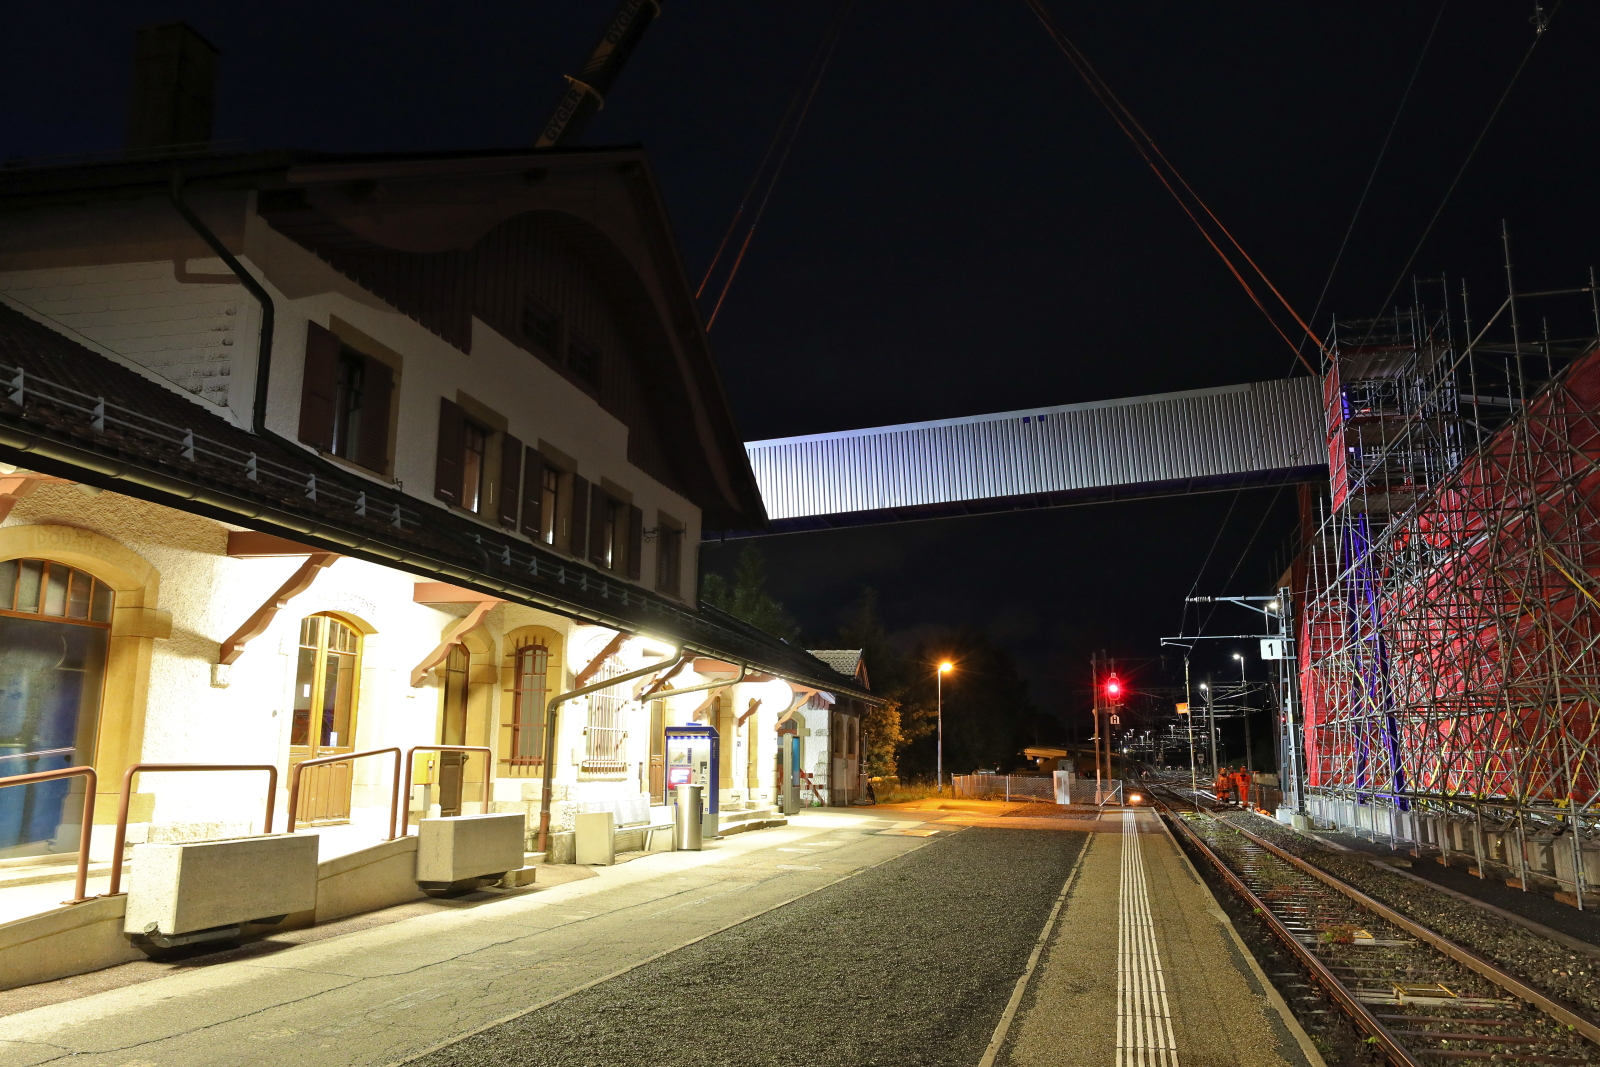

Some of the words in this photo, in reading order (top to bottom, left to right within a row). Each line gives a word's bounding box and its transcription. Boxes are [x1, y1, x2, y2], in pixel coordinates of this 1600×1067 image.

[544, 89, 582, 142] GYGER
[1268, 642, 1274, 657] 1
[1112, 716, 1118, 724] H
